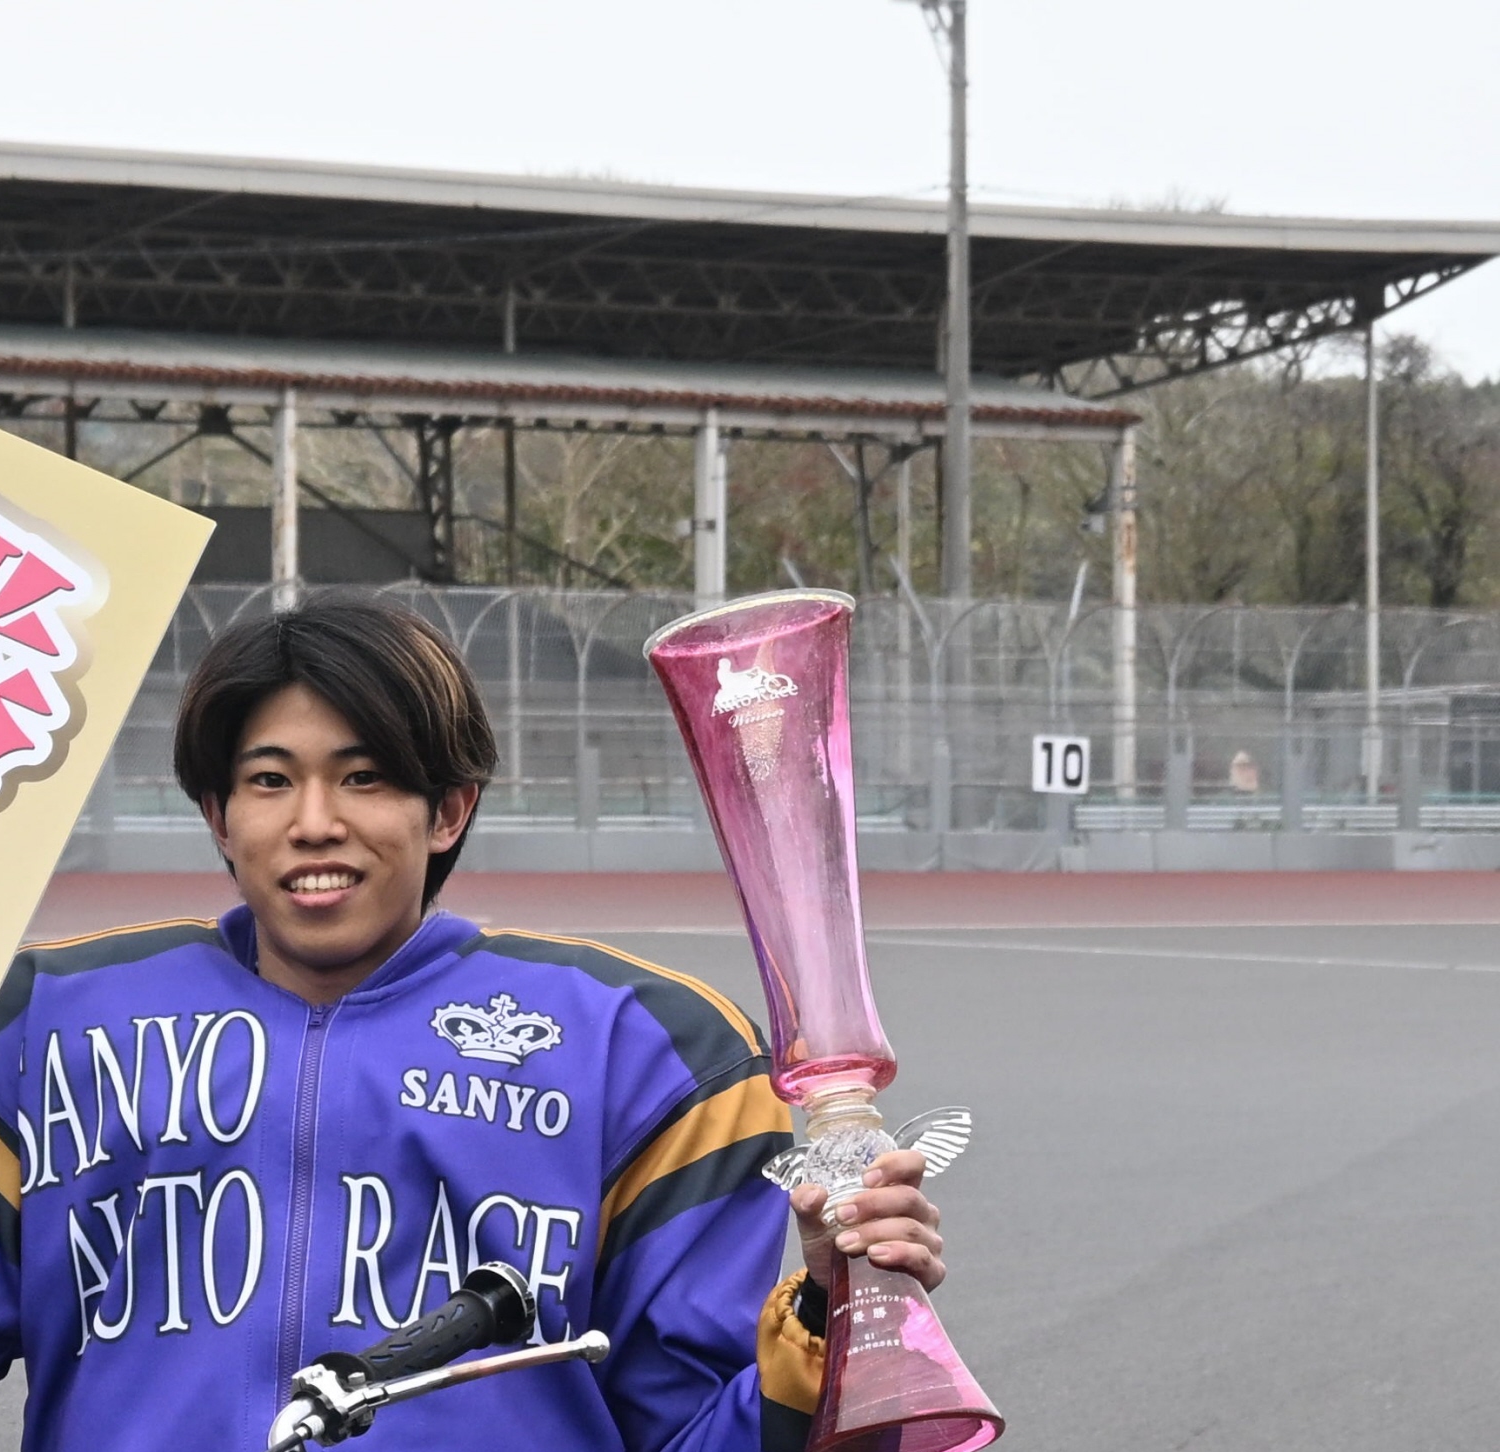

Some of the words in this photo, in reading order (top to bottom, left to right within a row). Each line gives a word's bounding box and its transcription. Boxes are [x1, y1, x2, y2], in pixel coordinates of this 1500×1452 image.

[728, 708, 785, 728] Winner
[1040, 741, 1084, 788] 10
[401, 1069, 570, 1137] SANYO
